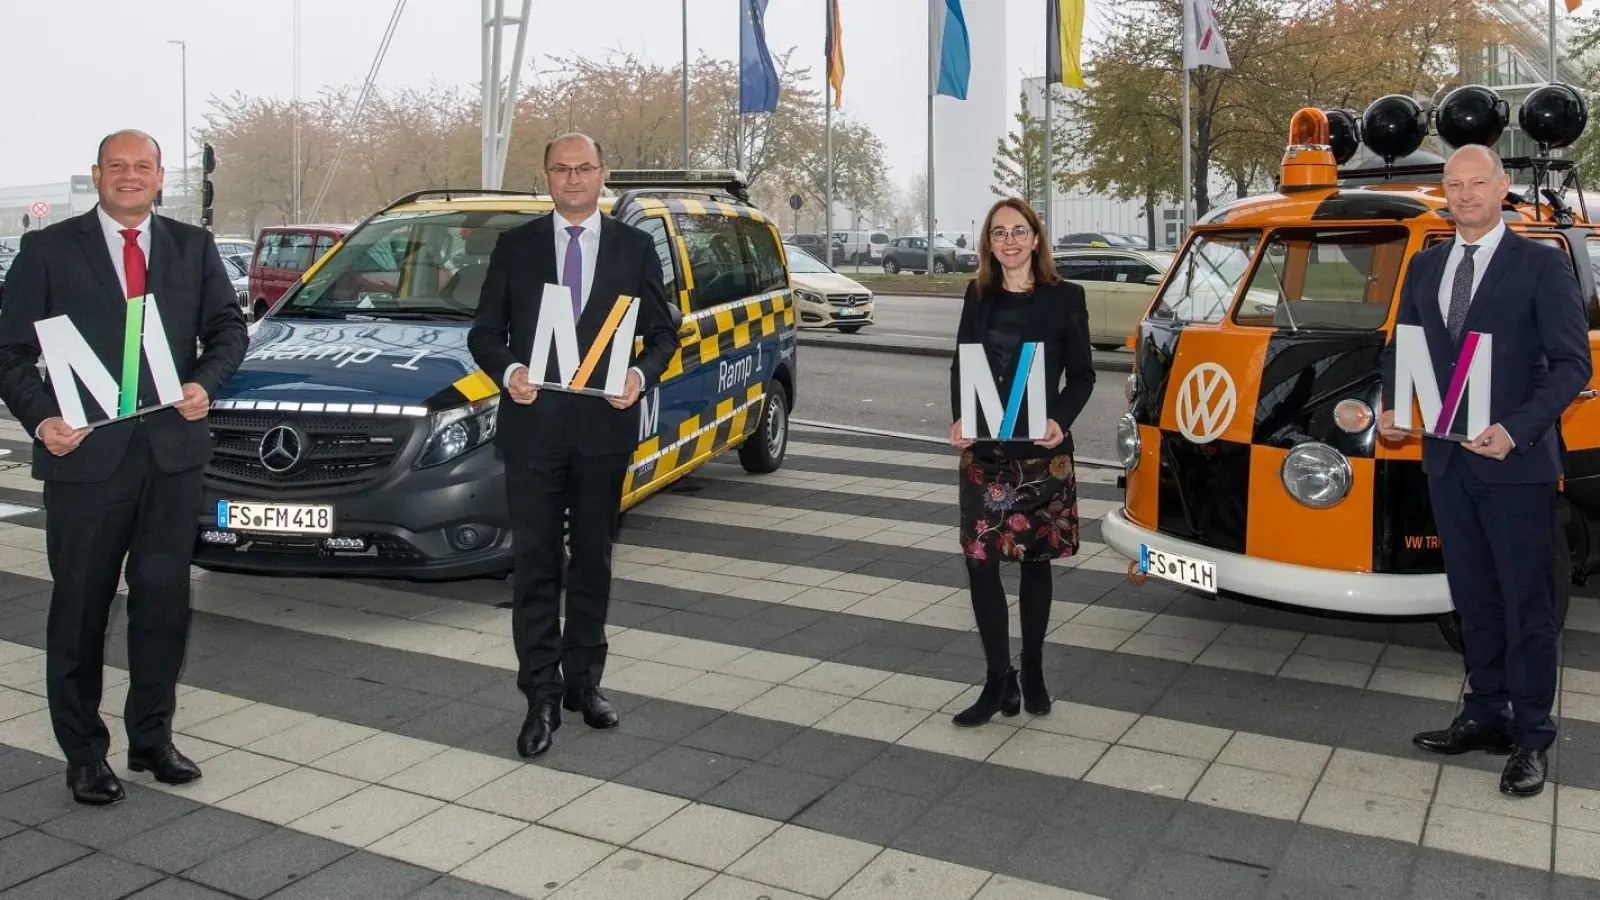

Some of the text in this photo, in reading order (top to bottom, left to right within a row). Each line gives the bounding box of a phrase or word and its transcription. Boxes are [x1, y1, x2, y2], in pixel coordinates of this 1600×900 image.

[34, 293, 184, 430] M
[391, 349, 431, 371] 1
[527, 282, 641, 397] M
[717, 355, 753, 394] Ramp
[755, 342, 763, 372] 1
[959, 342, 1047, 440] M
[1394, 324, 1492, 441] M
[638, 386, 660, 441] M
[228, 506, 328, 529] FS FM 418
[1404, 535, 1424, 549] VW
[1147, 551, 1166, 574] FS
[1177, 559, 1213, 588] T1H
